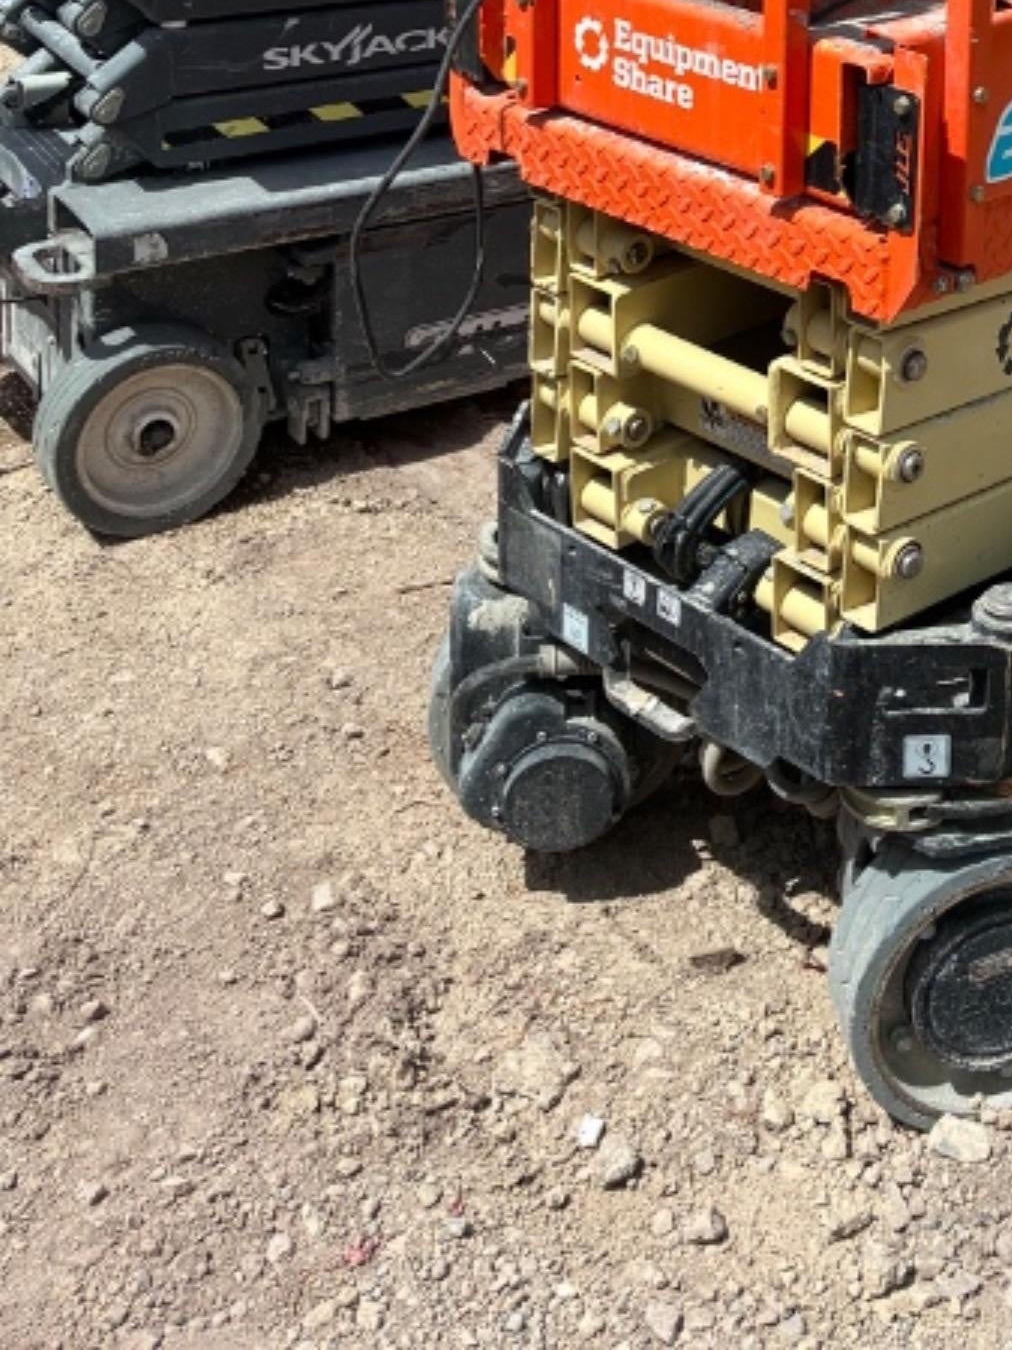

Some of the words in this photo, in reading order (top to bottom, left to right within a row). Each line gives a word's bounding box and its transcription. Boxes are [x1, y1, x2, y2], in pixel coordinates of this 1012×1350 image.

[262, 23, 452, 71] SKYJACK
[612, 17, 766, 93] Equipment
[611, 57, 695, 110] Share
